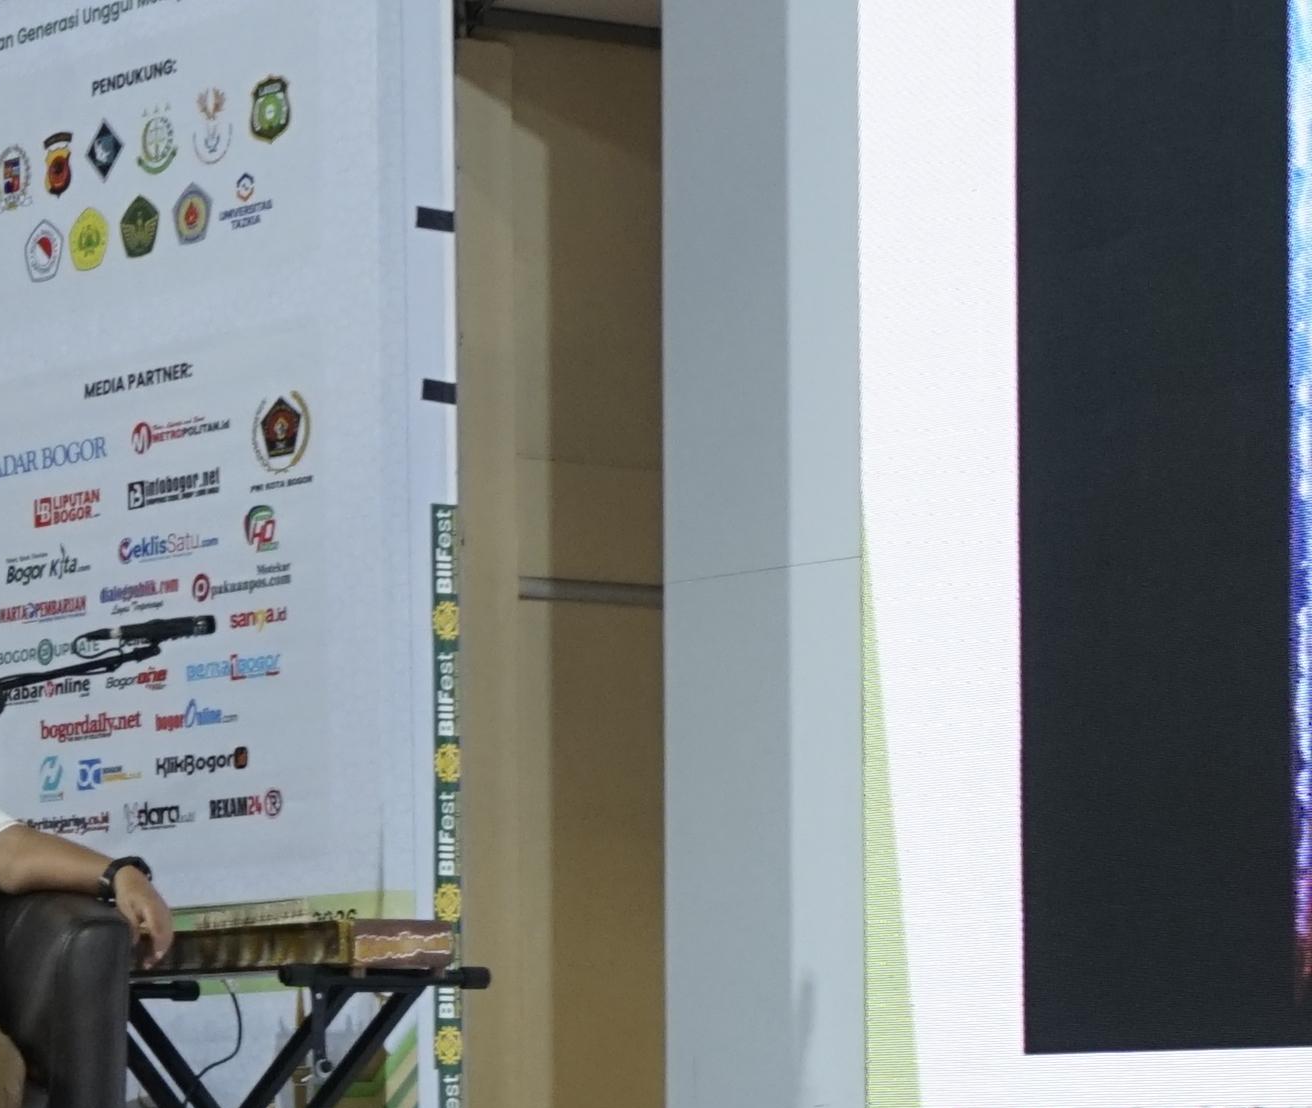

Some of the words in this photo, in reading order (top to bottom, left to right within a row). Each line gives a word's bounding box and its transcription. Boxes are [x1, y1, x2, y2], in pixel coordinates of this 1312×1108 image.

[17, 13, 79, 45] Generasi
[91, 59, 178, 96] PENDUKUNG:
[83, 376, 125, 399] MEDIA
[128, 363, 194, 391] PARTNER:
[41, 436, 108, 470] BOGOR
[53, 489, 101, 510] LIPUTAN
[53, 506, 92, 525] BOGOR
[6, 564, 46, 586] Bogor
[53, 639, 100, 658] UPATE
[40, 711, 142, 743] bogordaily.net
